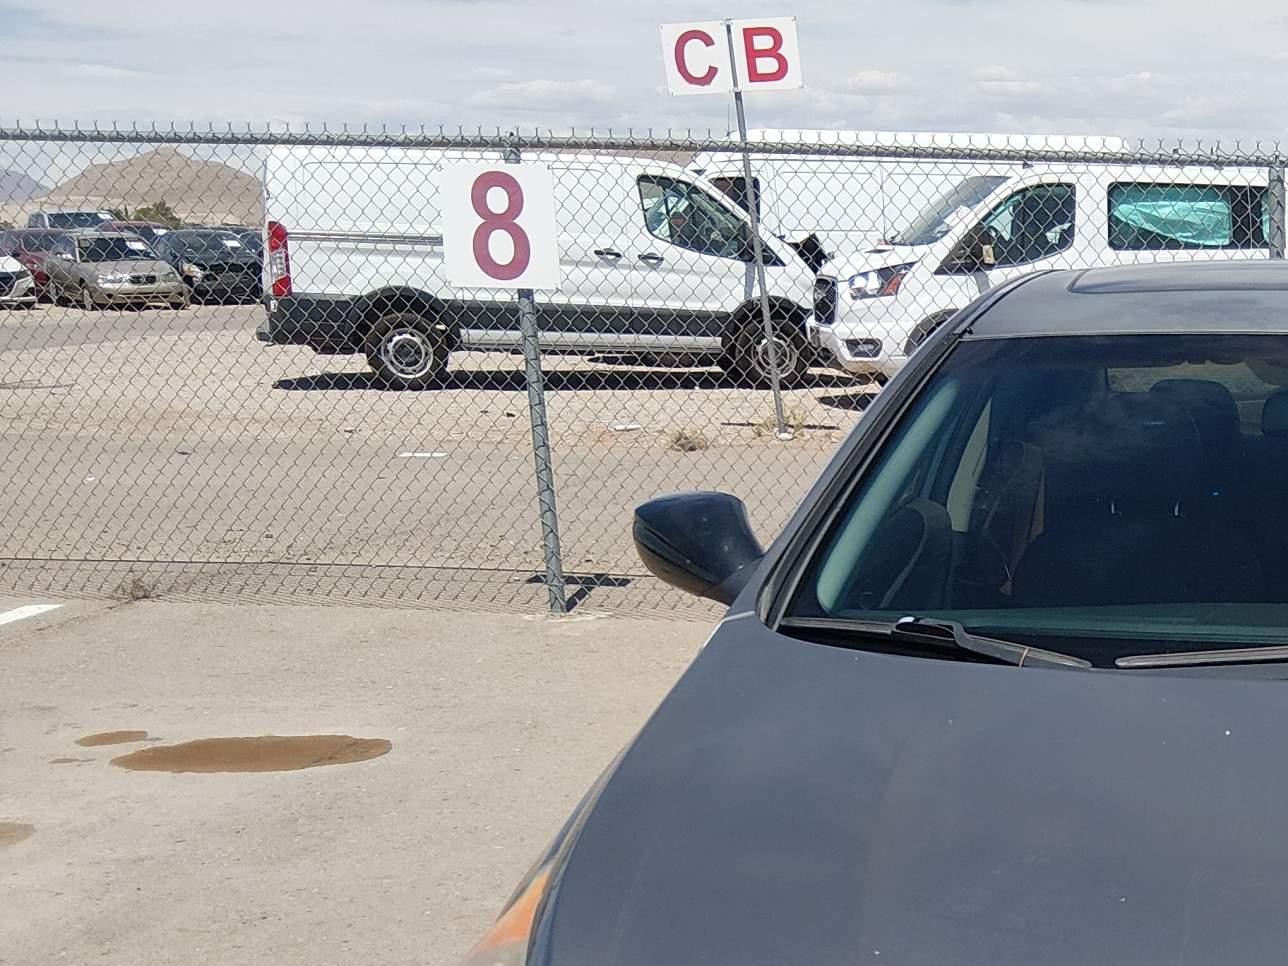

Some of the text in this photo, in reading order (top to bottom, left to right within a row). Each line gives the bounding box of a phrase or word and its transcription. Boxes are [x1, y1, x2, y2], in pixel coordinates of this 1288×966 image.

[674, 29, 719, 87] C
[742, 26, 789, 83] B
[471, 170, 531, 281] 8
